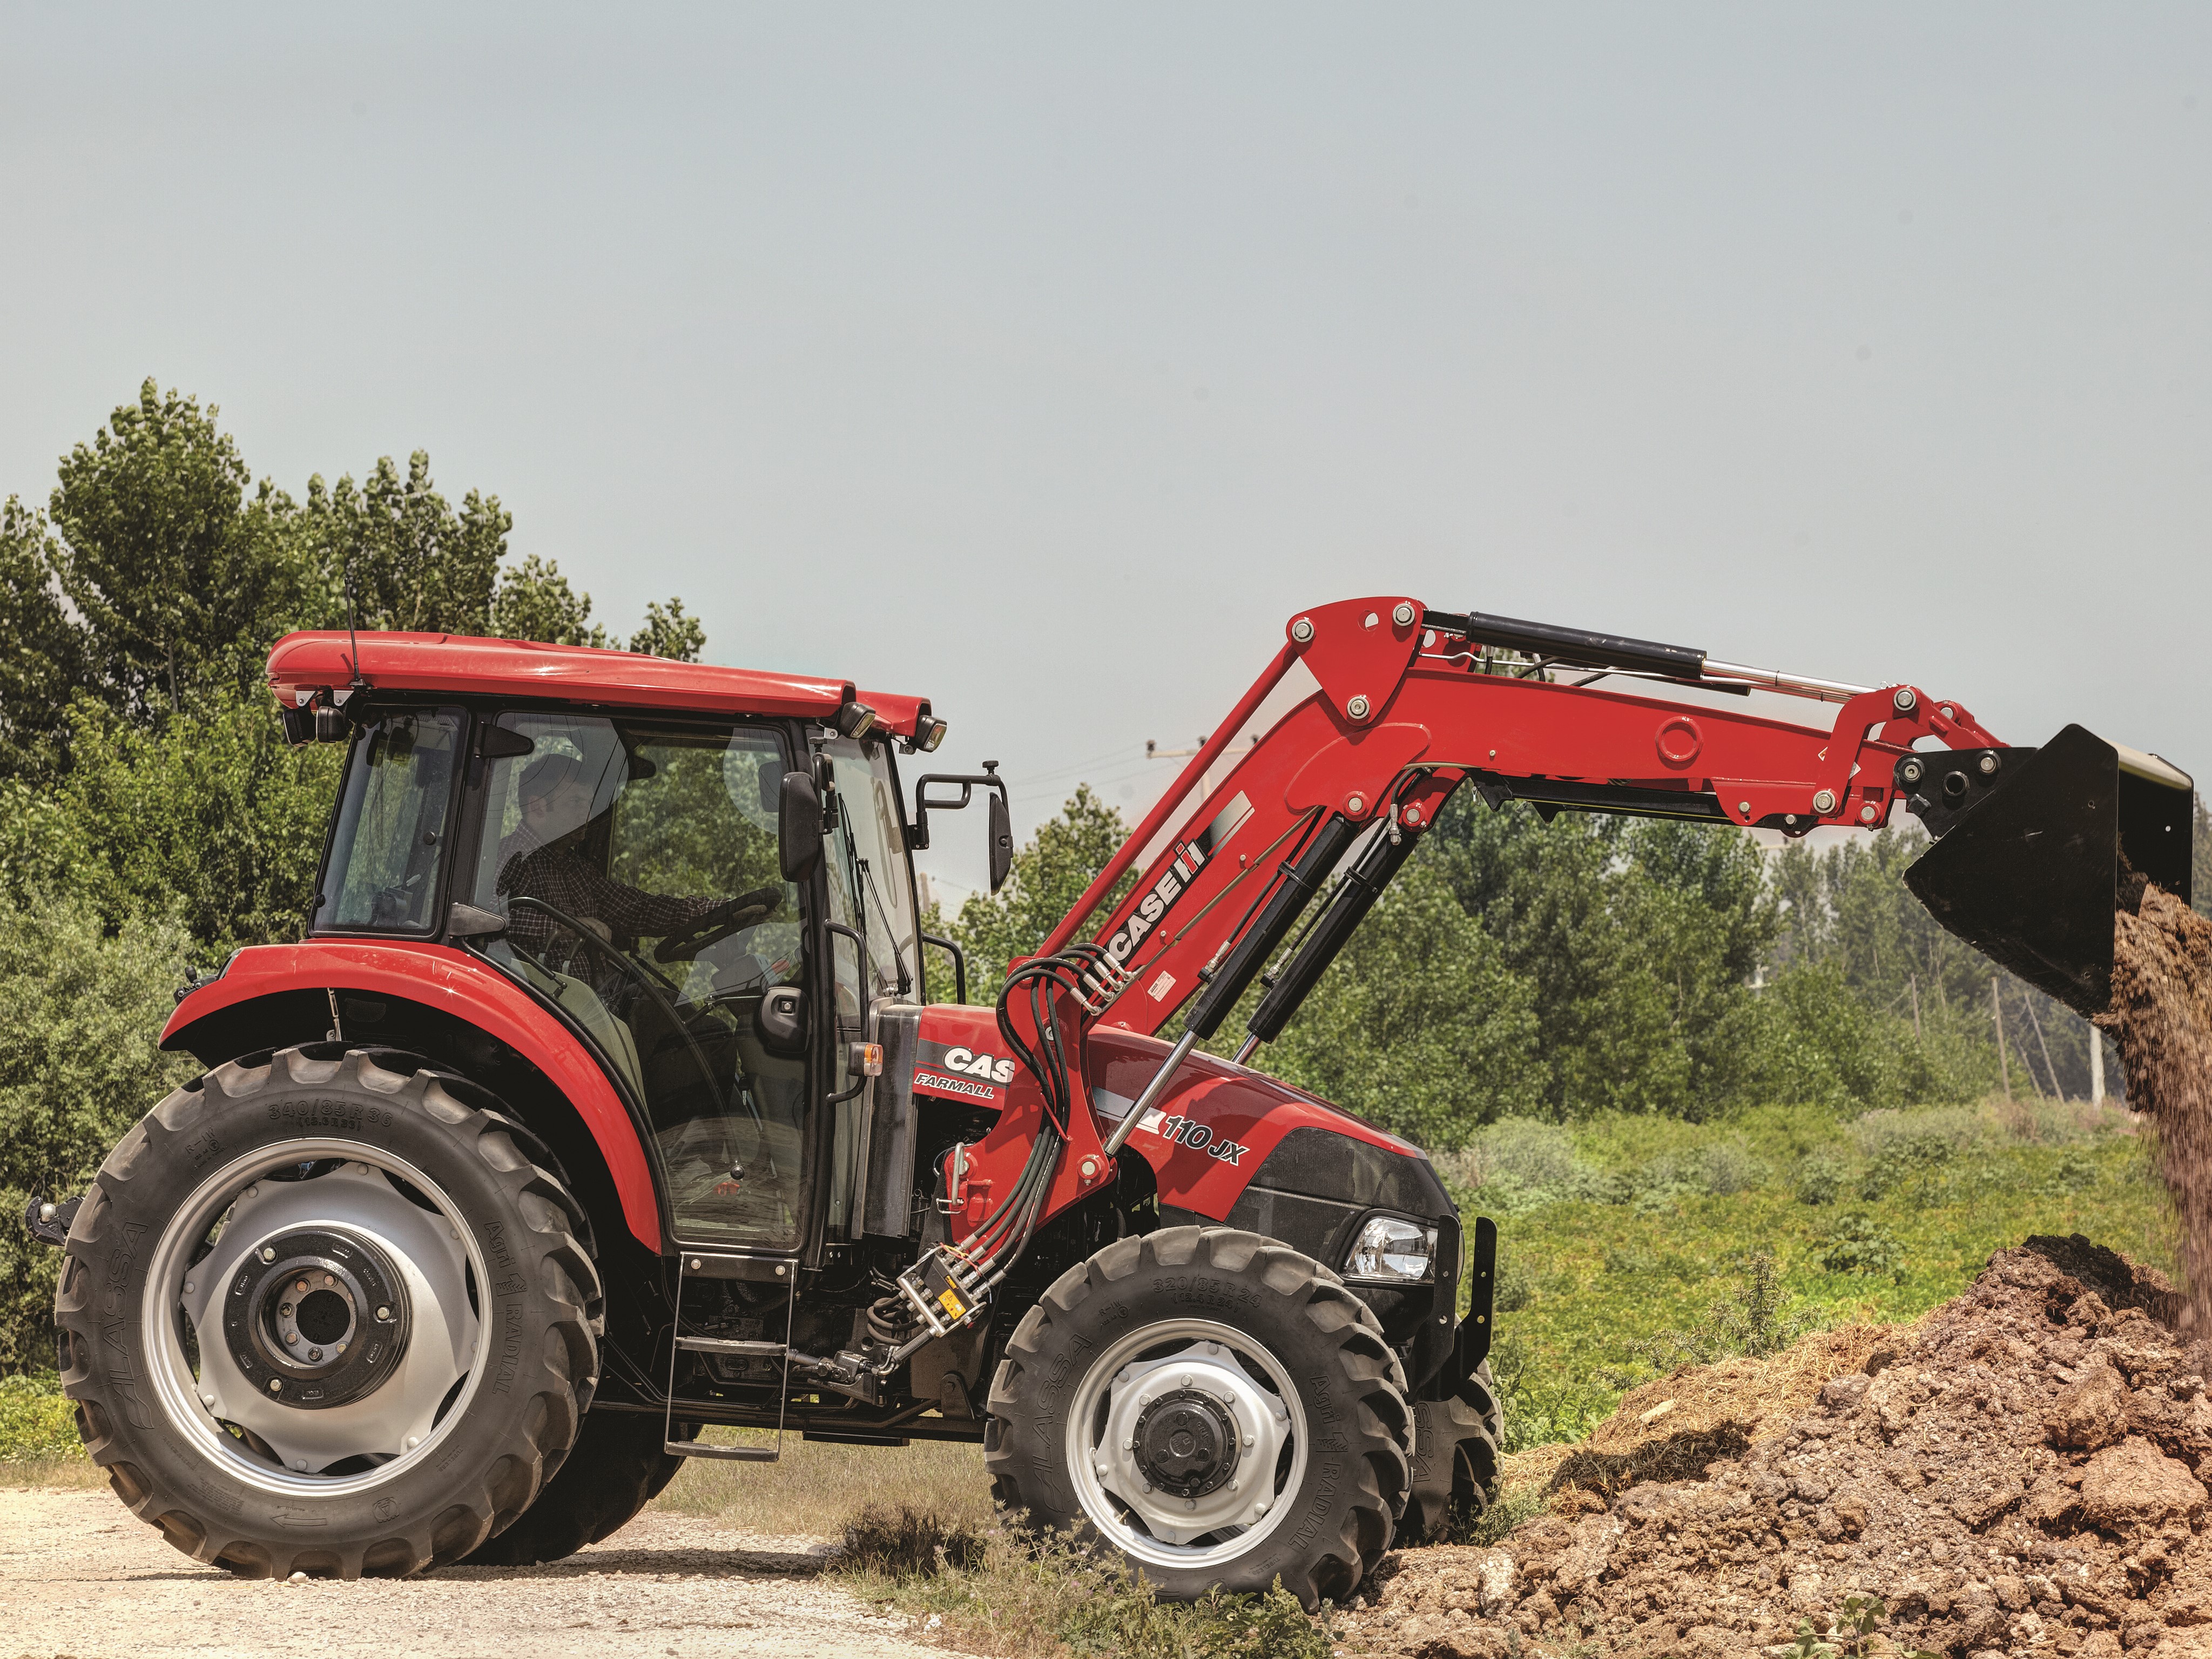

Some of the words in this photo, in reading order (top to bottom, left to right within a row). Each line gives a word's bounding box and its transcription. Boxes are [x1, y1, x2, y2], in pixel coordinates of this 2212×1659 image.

[1109, 870, 1182, 961] CASE
[914, 1073, 995, 1100] FARMALL
[944, 1047, 1015, 1083] CAS
[268, 1098, 346, 1120] 340/85
[350, 1103, 364, 1120] R
[367, 1108, 393, 1127] 36
[1162, 1115, 1213, 1150] 110
[1207, 1138, 1251, 1166] JX
[483, 1220, 516, 1268] Agri
[1152, 1276, 1220, 1293] 320/85
[1223, 1282, 1237, 1298] R
[1237, 1287, 1263, 1308] 24
[491, 1304, 523, 1394] RADIAL
[1032, 1333, 1093, 1468] LASSA
[1309, 1375, 1341, 1424] Agri
[1412, 1402, 1434, 1483] SSA
[1287, 1462, 1341, 1550] RADIAL
